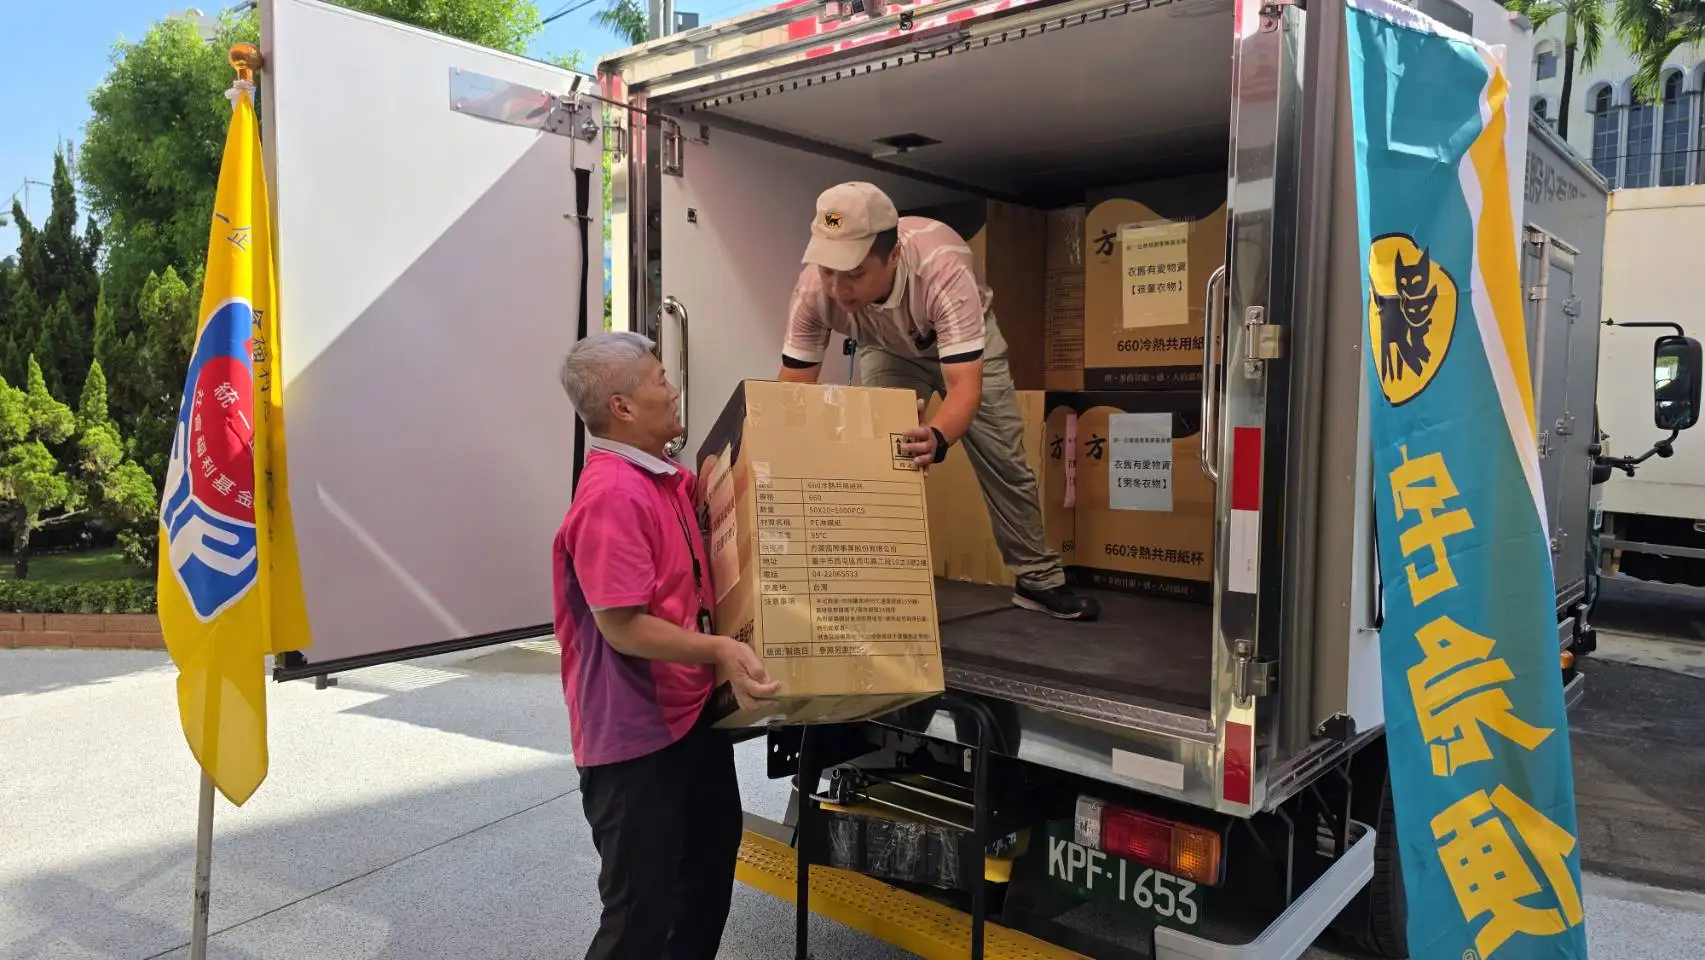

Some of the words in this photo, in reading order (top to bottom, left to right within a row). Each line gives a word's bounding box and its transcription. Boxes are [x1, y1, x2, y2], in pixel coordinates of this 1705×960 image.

[1093, 229, 1117, 256] 方
[1084, 434, 1106, 460] 方
[1114, 460, 1171, 471] 衣舊有愛物資
[1104, 543, 1205, 565] 660冷熱共用紙杯
[1388, 445, 1584, 960] 宅急便
